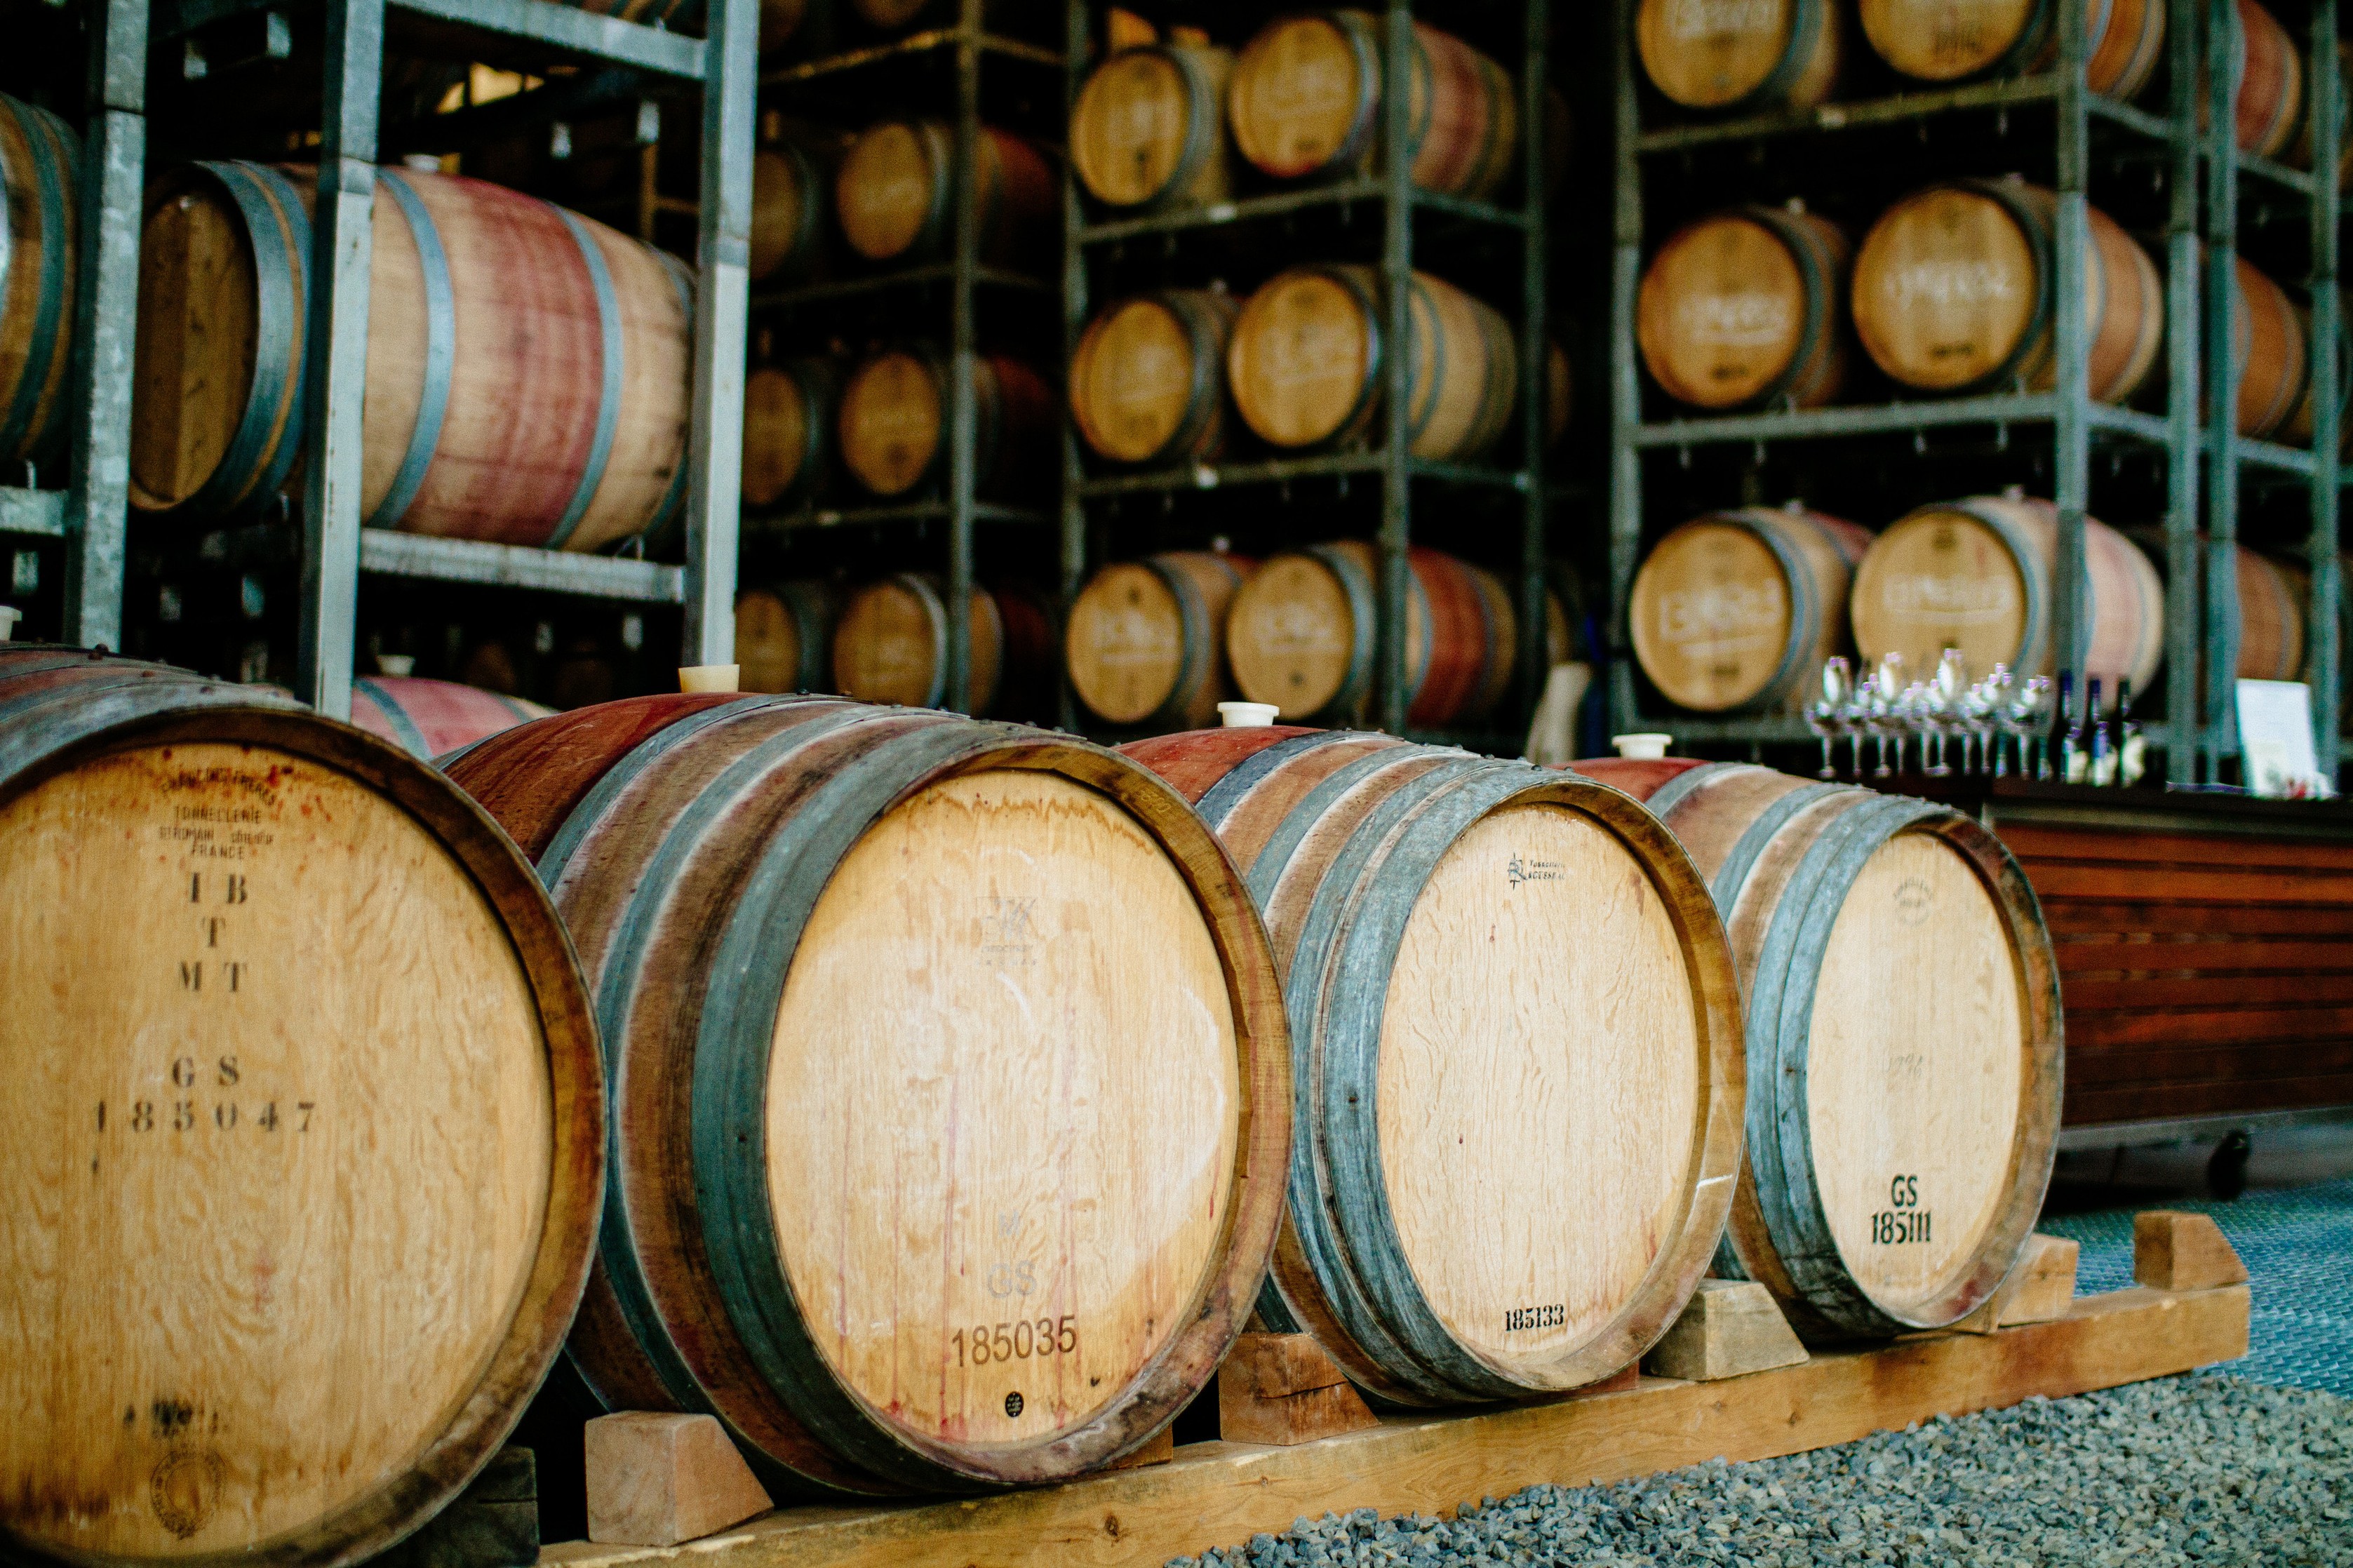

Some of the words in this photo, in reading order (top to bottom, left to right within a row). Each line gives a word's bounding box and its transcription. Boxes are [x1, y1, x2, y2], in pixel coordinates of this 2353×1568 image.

[1891, 1174, 1918, 1207] GS
[1871, 1210, 1931, 1245] 185111
[987, 1259, 1038, 1299] GS
[1505, 1304, 1564, 1332] 185133
[952, 1314, 1077, 1367] 185035
